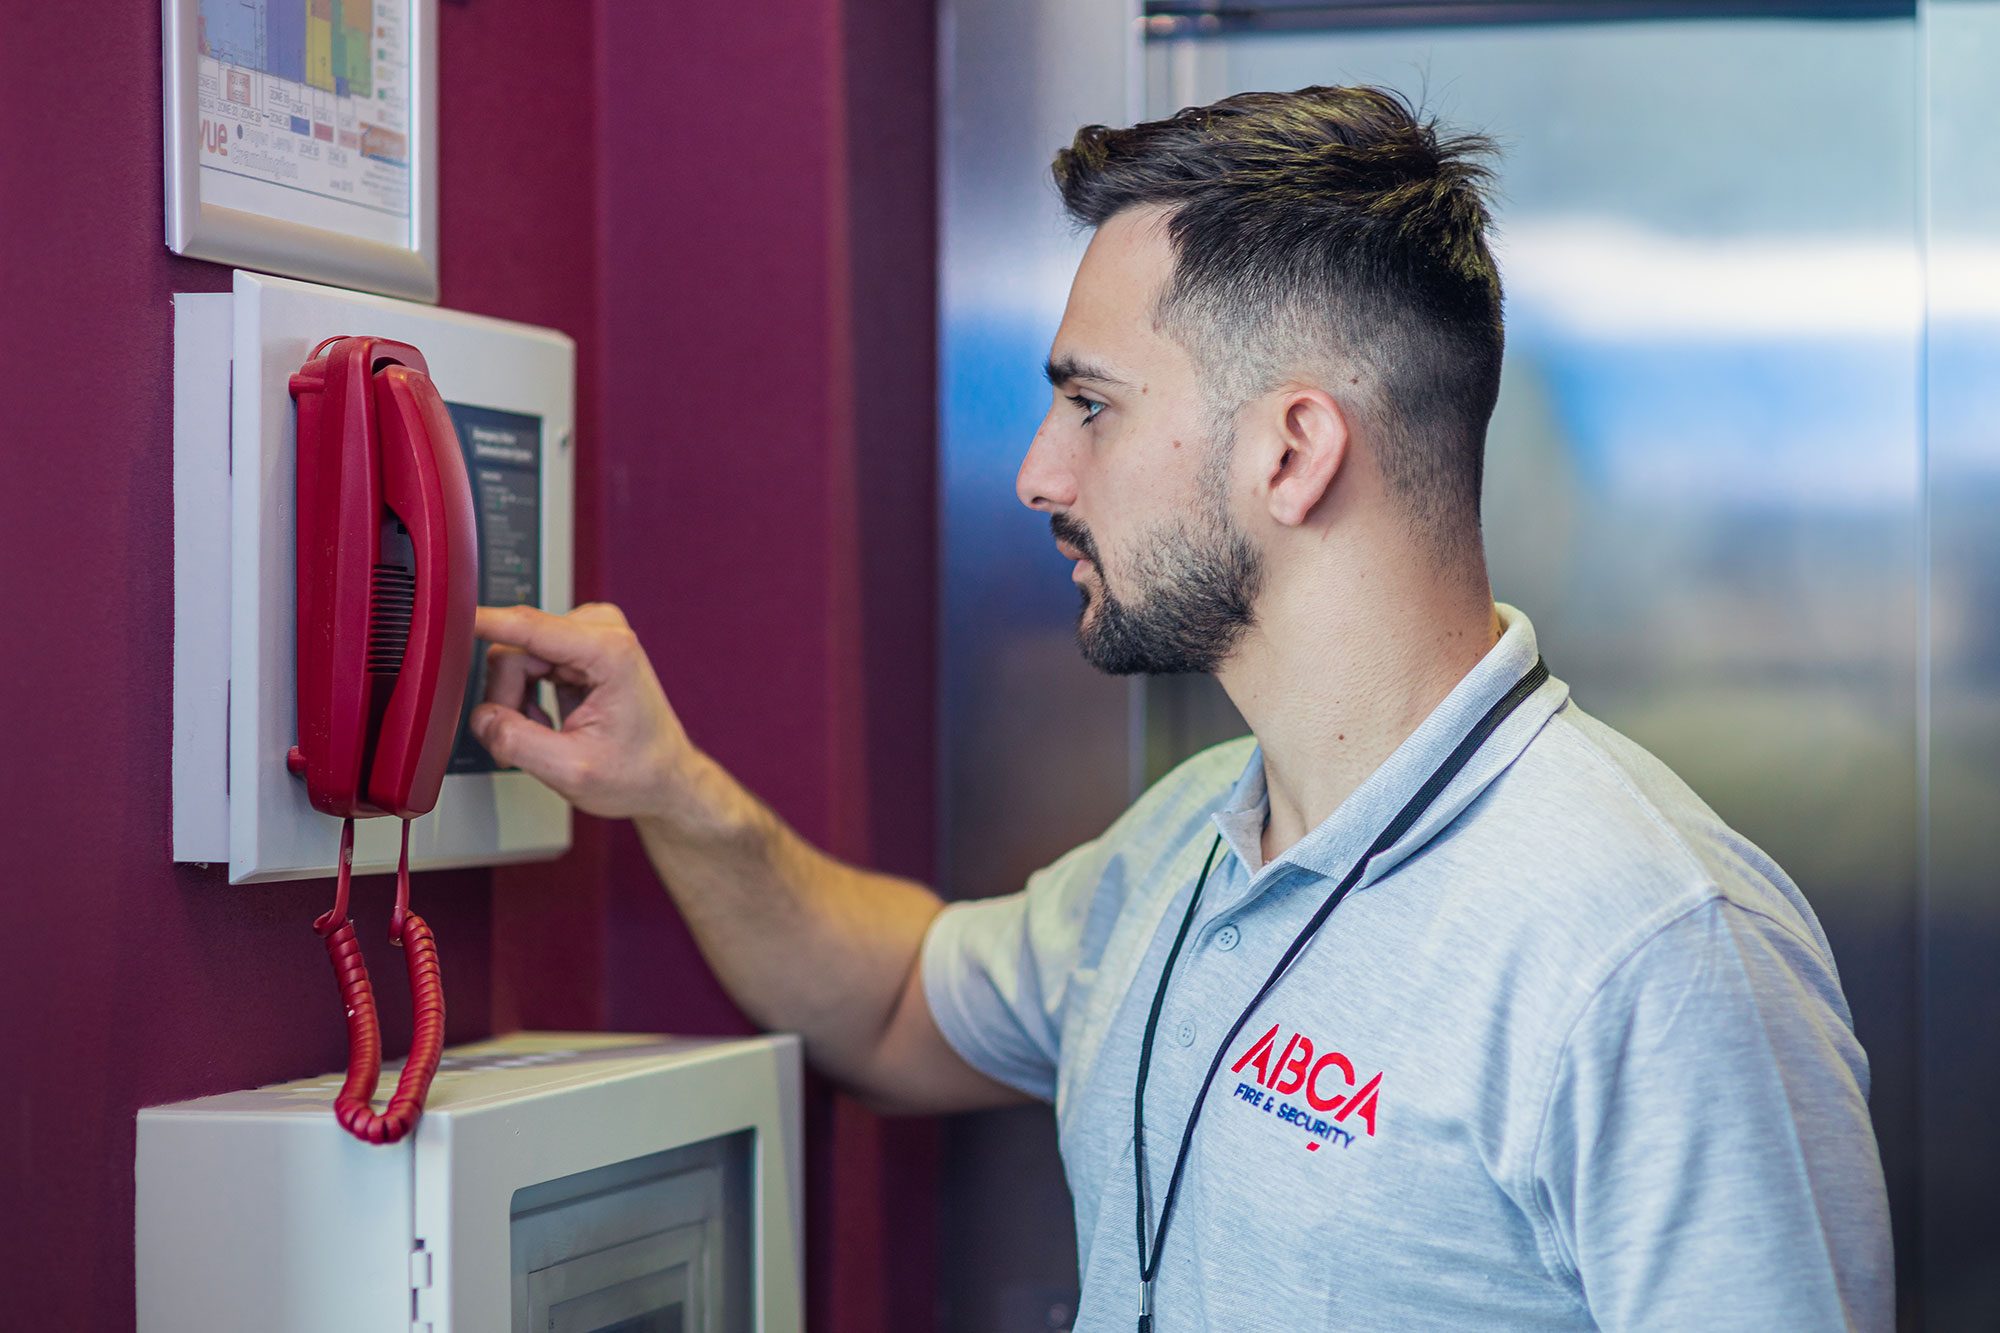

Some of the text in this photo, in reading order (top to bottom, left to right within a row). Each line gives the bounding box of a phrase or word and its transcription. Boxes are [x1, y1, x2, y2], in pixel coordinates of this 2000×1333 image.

[1231, 1023, 1383, 1137] ABCA
[1233, 1082, 1356, 1149] FIRE & SECURITY
